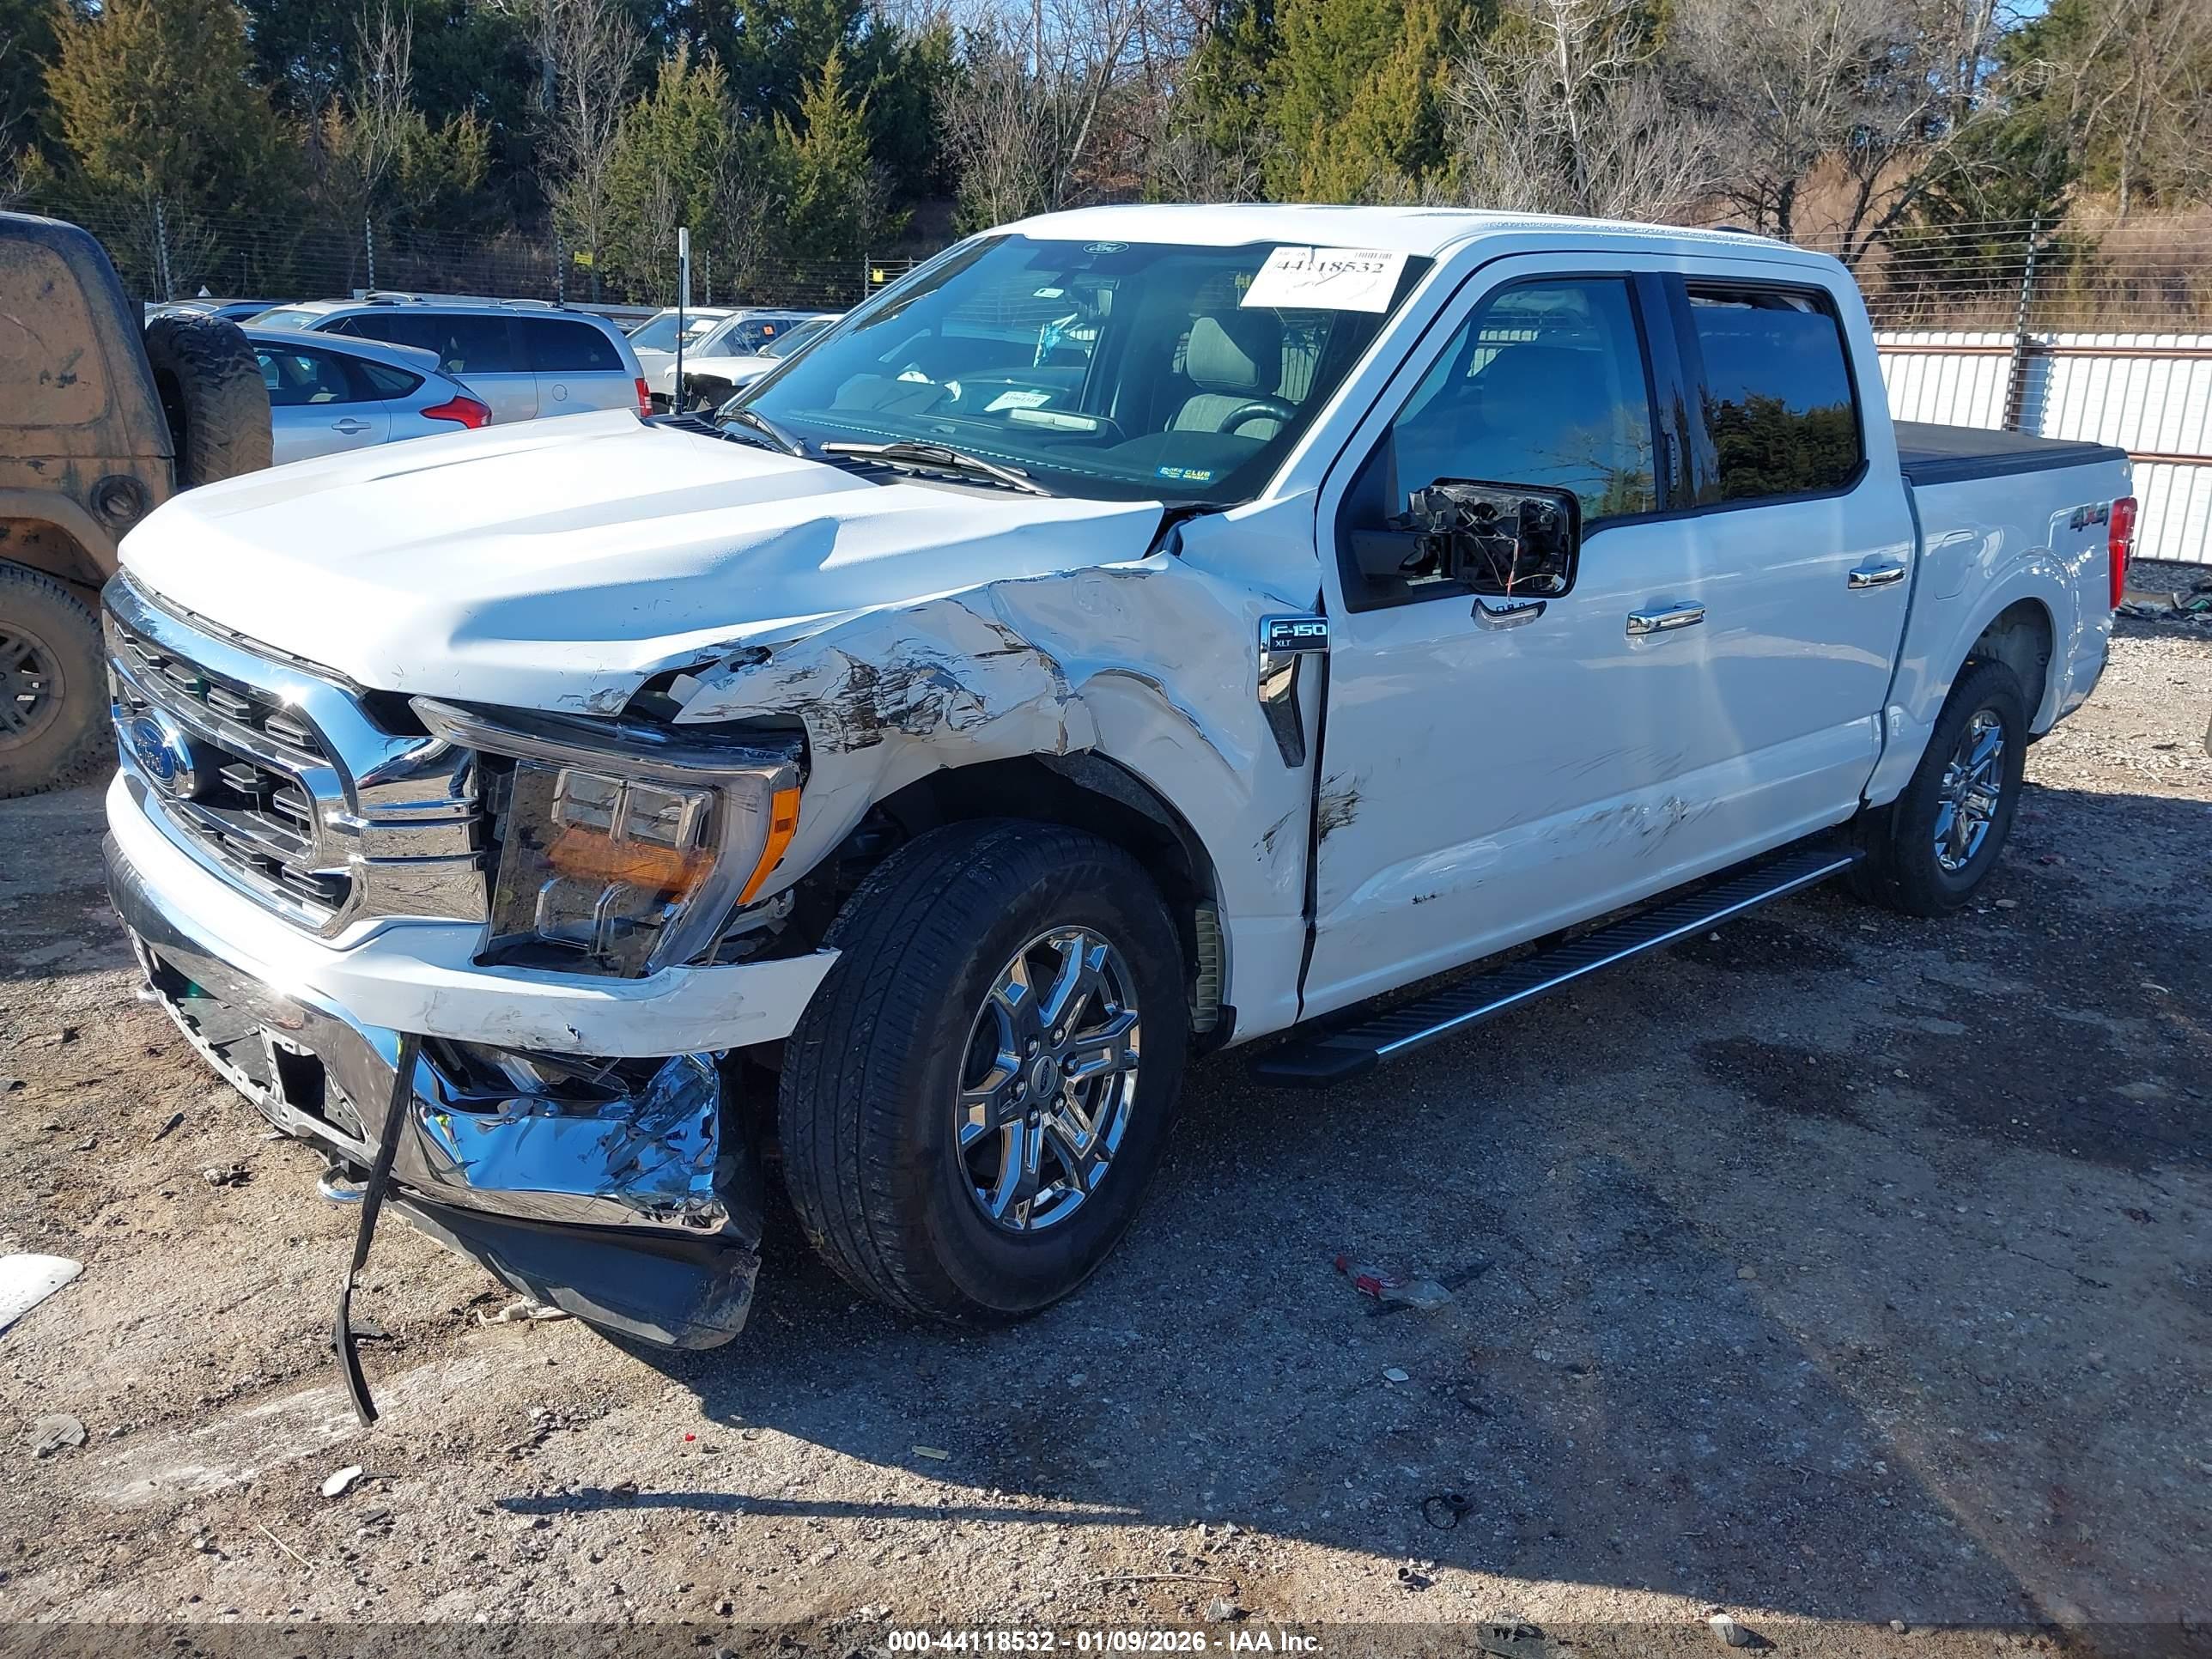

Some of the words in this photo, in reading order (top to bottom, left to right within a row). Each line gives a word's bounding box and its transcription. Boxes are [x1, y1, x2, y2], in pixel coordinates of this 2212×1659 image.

[1275, 260, 1384, 274] 44118532
[1272, 623, 1327, 637] F-150
[1274, 639, 1291, 647] XLT
